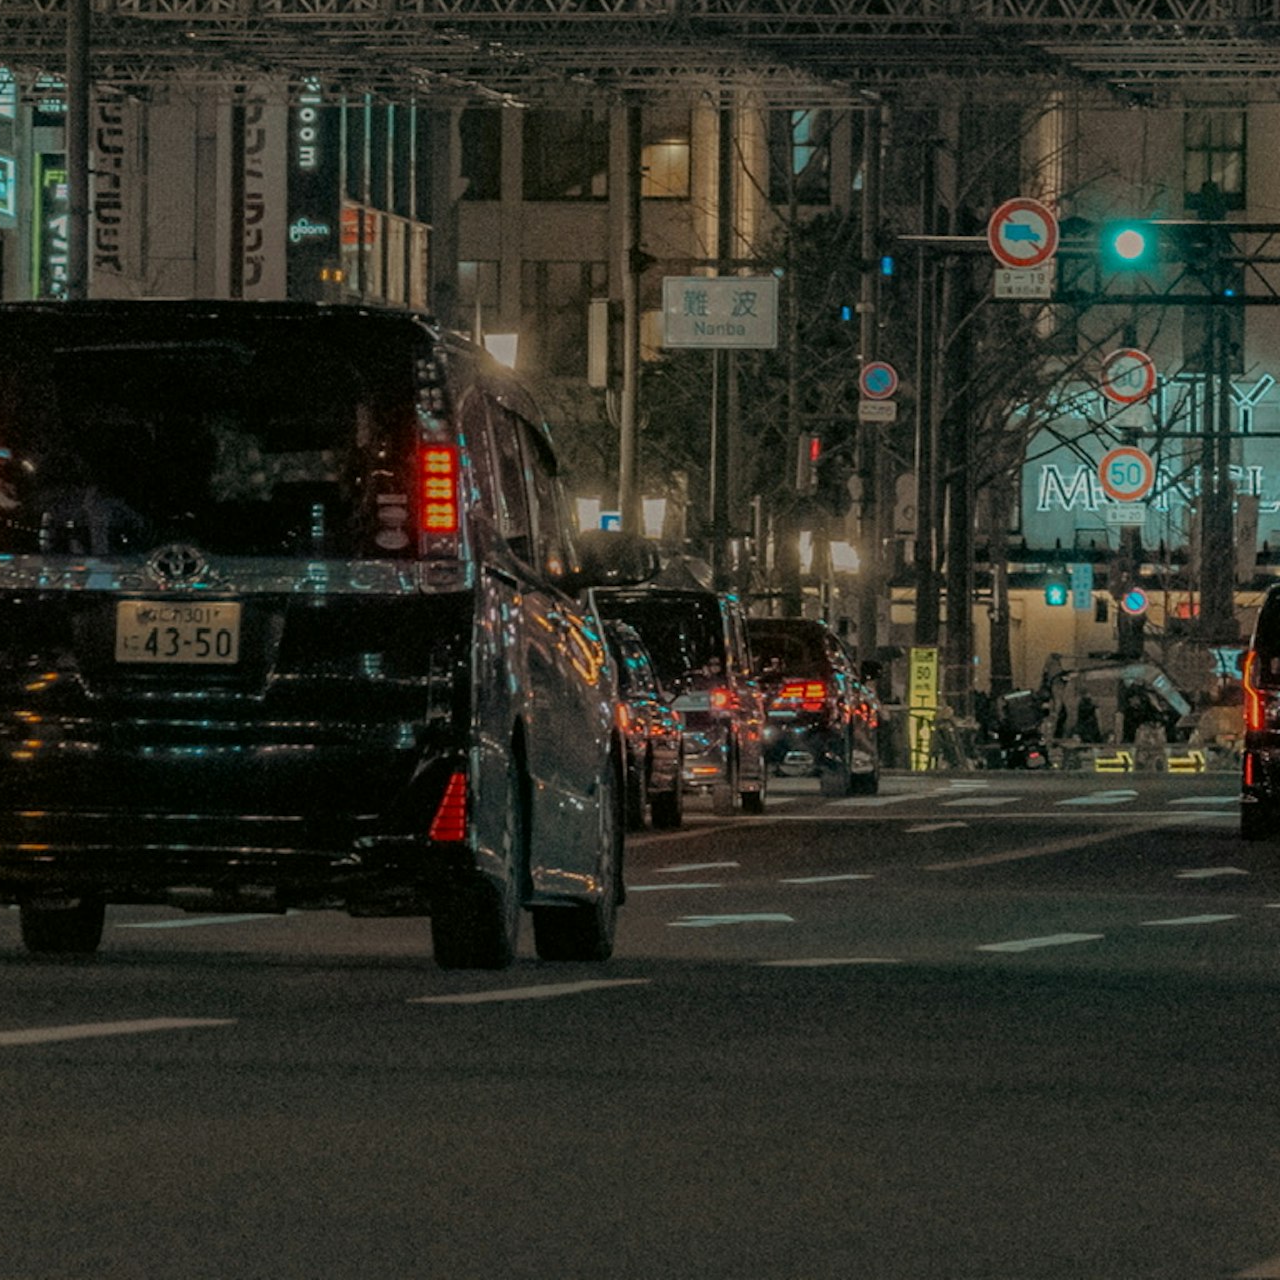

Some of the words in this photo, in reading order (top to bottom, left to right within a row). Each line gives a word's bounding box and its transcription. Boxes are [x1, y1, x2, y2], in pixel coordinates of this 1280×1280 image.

[683, 289, 758, 318] 難波
[694, 322, 746, 337] Nanba
[1110, 462, 1142, 486] 50
[144, 627, 232, 657] 43-50
